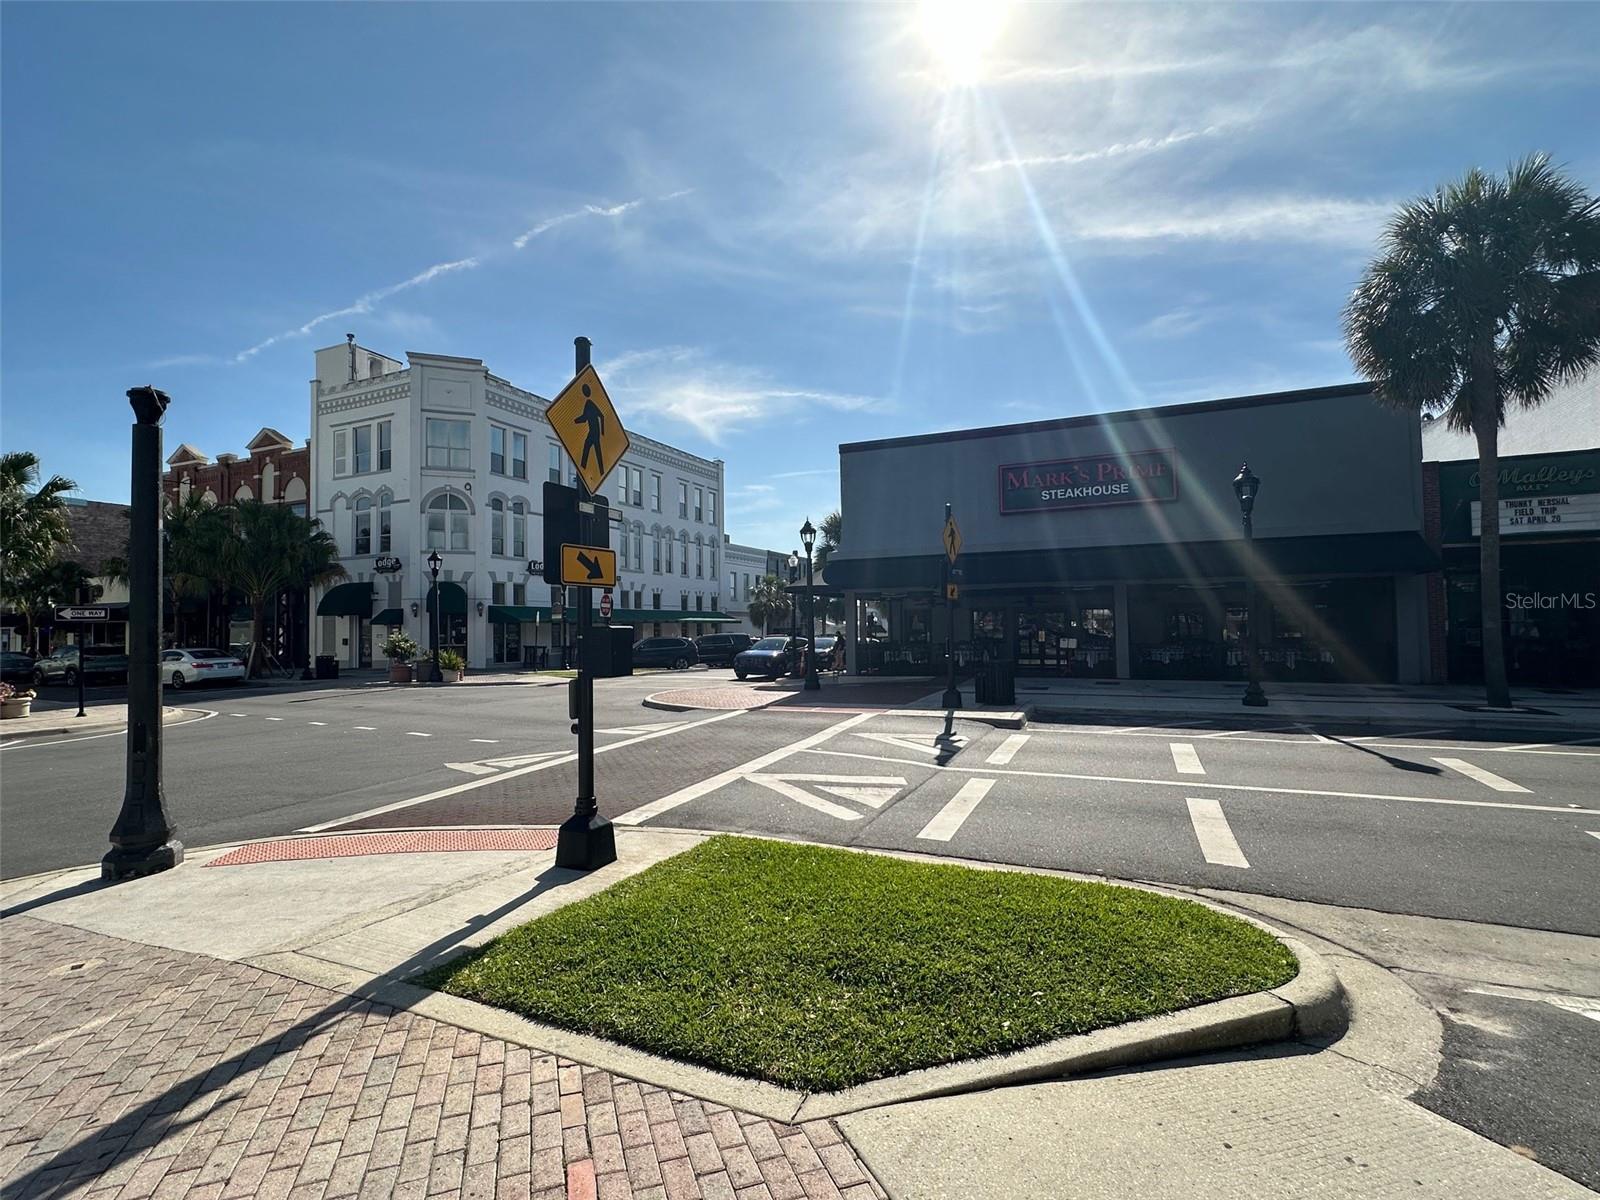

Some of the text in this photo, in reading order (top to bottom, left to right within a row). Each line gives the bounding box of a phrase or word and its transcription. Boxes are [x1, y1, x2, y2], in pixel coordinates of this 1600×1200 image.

[1041, 484, 1129, 501] STEAKHOUSE
[1505, 499, 1532, 508] THUNKY
[1514, 506, 1557, 516] FIELD TRIP
[1510, 514, 1561, 525] SAT APRIL 20
